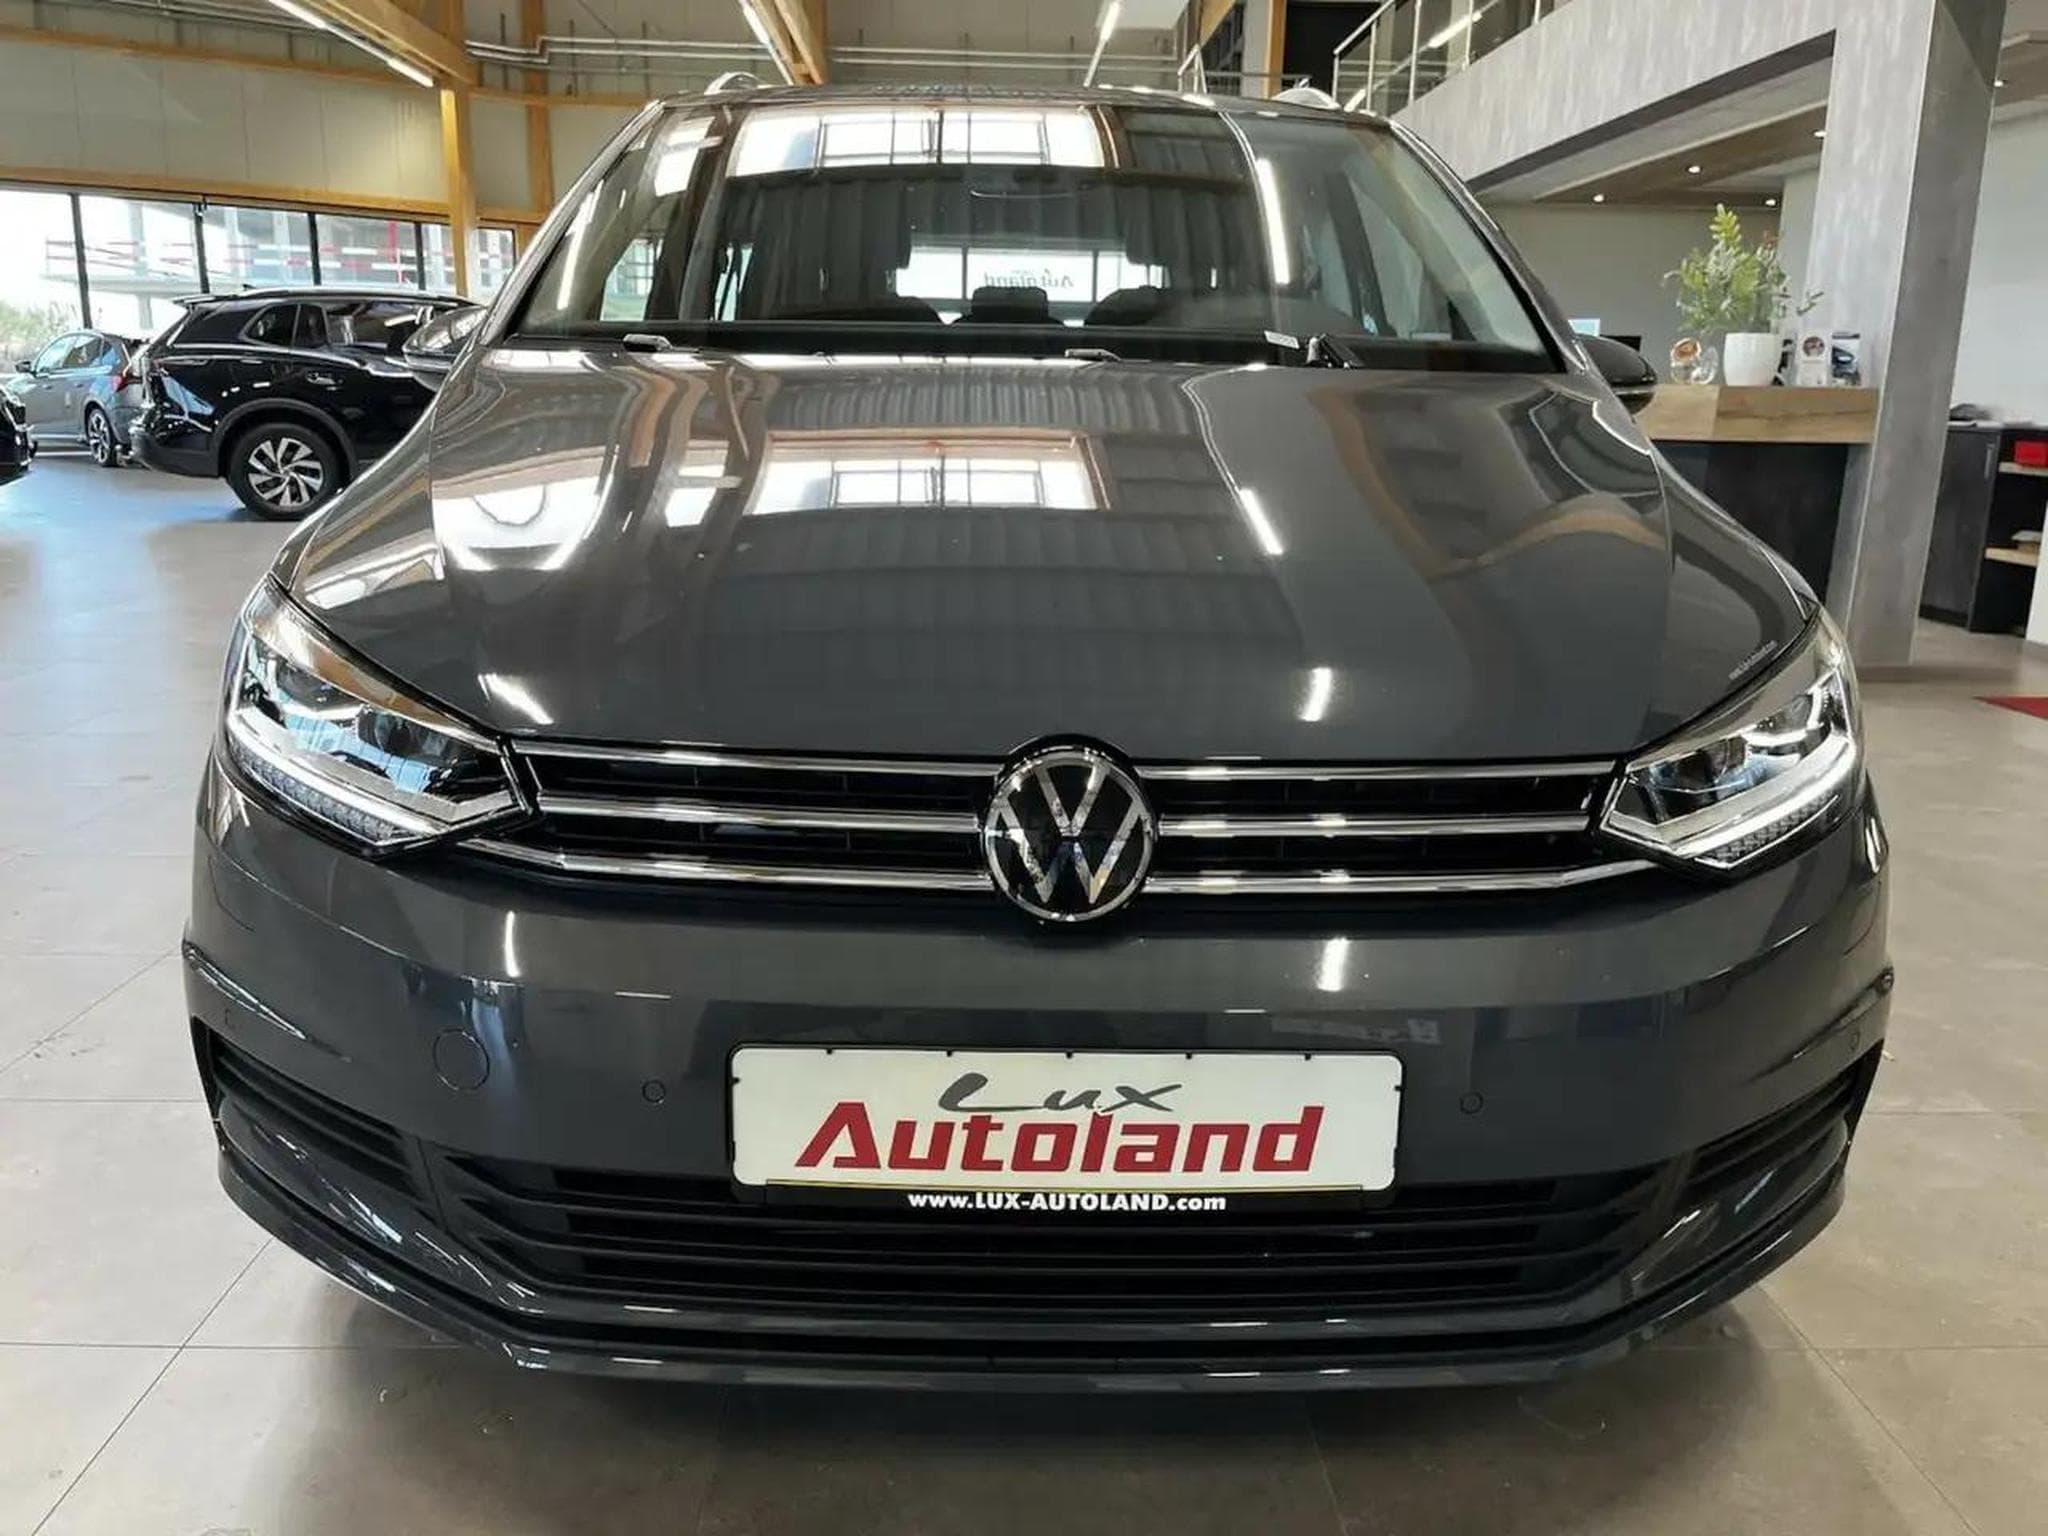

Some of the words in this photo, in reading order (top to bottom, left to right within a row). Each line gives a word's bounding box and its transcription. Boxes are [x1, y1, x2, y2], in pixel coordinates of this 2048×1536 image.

[938, 1073, 1182, 1112] Lux
[794, 1101, 1325, 1173] Autoland
[908, 1192, 1227, 1212] www.LUX-AUTOLAND.com
